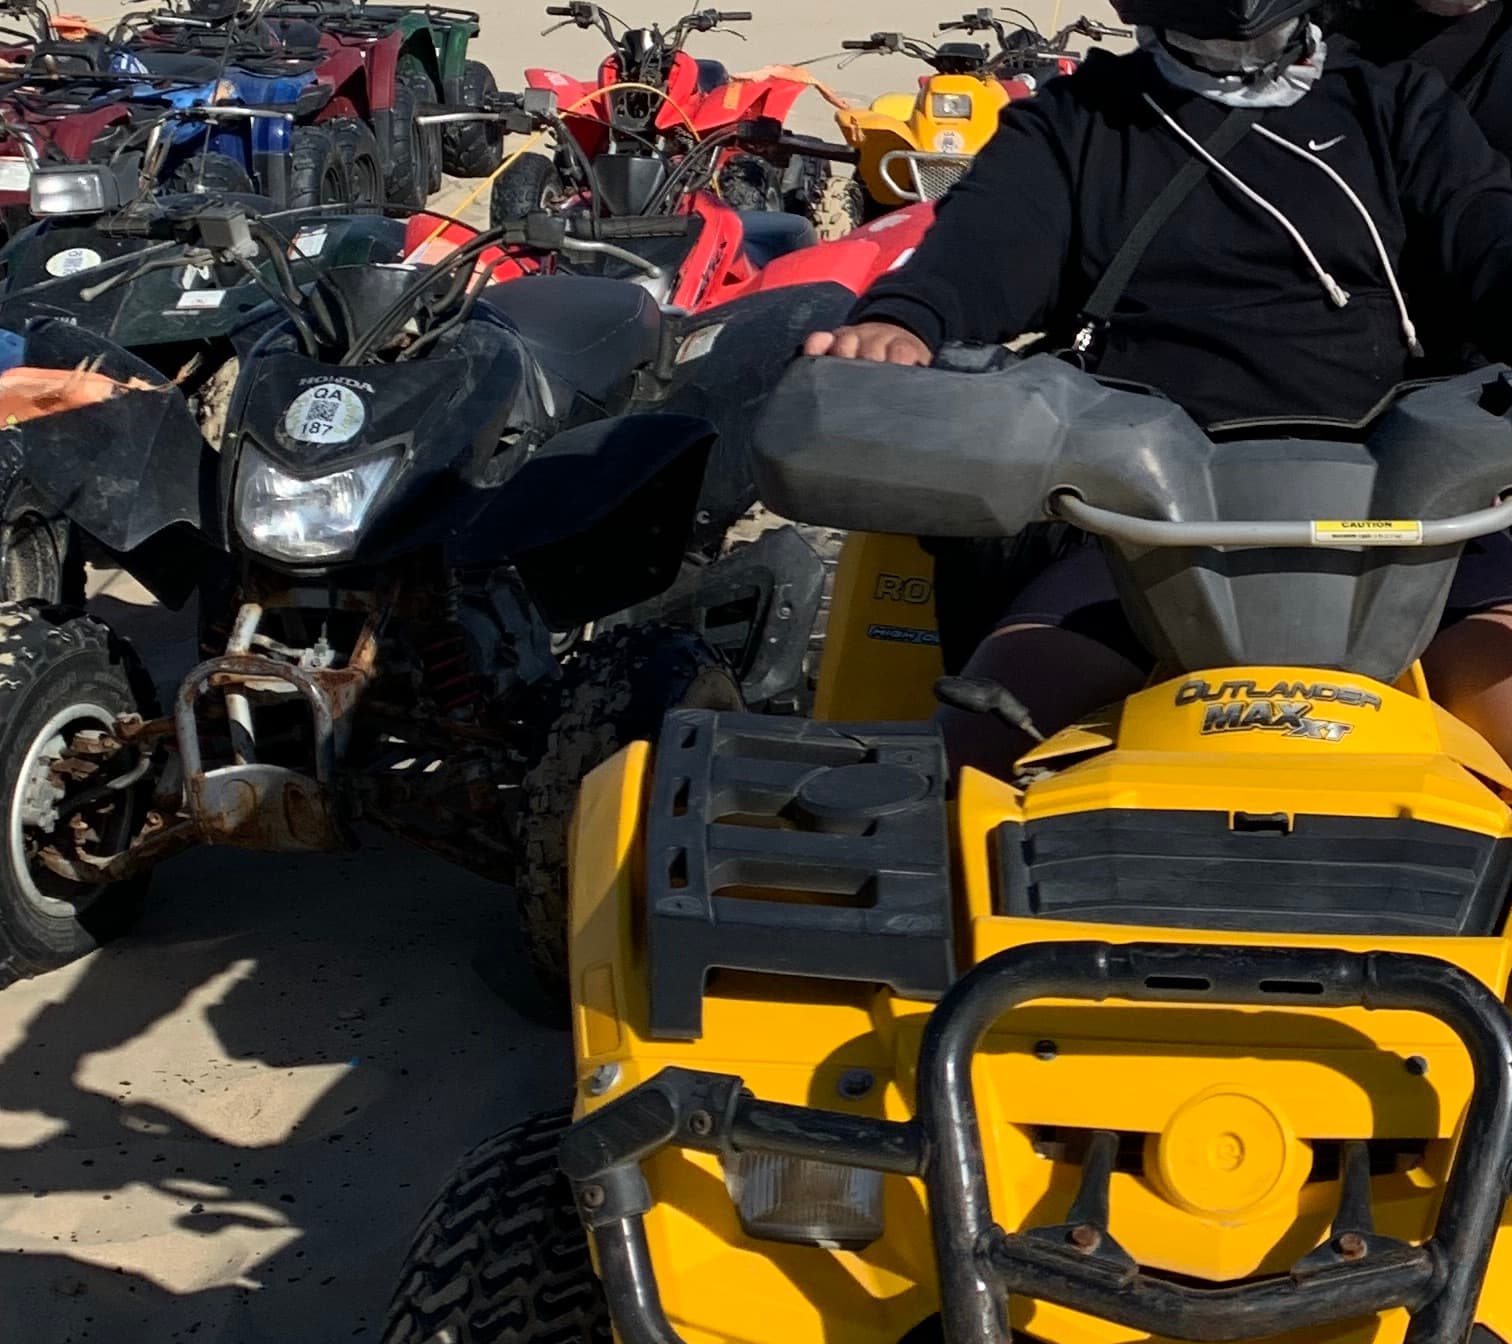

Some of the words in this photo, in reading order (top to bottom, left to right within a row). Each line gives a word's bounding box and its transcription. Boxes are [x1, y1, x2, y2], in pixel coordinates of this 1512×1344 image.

[298, 375, 376, 394] HONDA
[314, 387, 342, 401] QA
[302, 421, 334, 436] 187
[1341, 521, 1392, 529] CAUTION
[1174, 680, 1383, 712] OUTLANDER
[1201, 699, 1312, 735] MAX
[1282, 718, 1354, 743] XT
